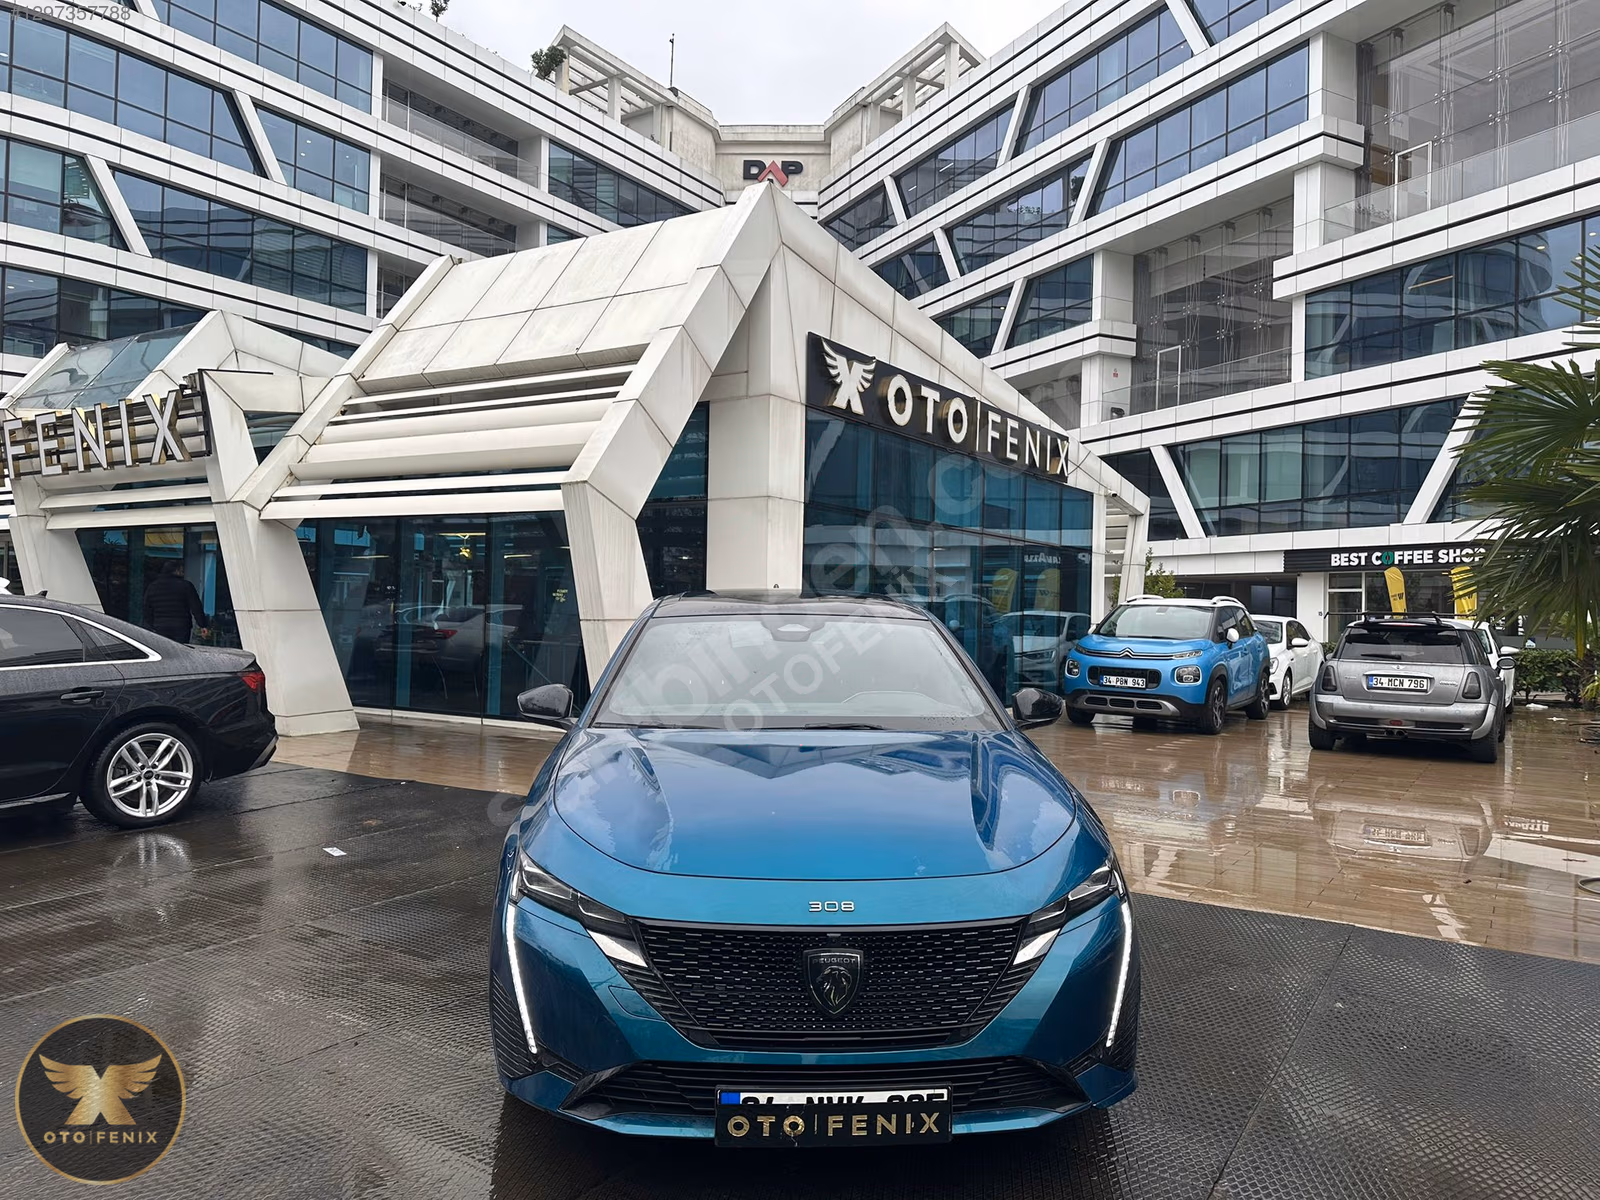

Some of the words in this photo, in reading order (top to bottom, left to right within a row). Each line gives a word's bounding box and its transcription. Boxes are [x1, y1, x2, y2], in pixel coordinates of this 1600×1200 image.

[743, 160, 804, 187] DAP
[3, 389, 192, 480] FENIX
[885, 373, 968, 444] OTO
[987, 410, 1069, 477] FENIX
[1331, 553, 1368, 567] BEST
[1372, 550, 1434, 566] COFFEE
[1373, 677, 1384, 686] 34
[1388, 678, 1404, 688] MCN
[1408, 679, 1425, 688] 796
[808, 901, 855, 912] 308
[727, 1115, 805, 1137] OTO
[827, 1112, 940, 1137] FENIX
